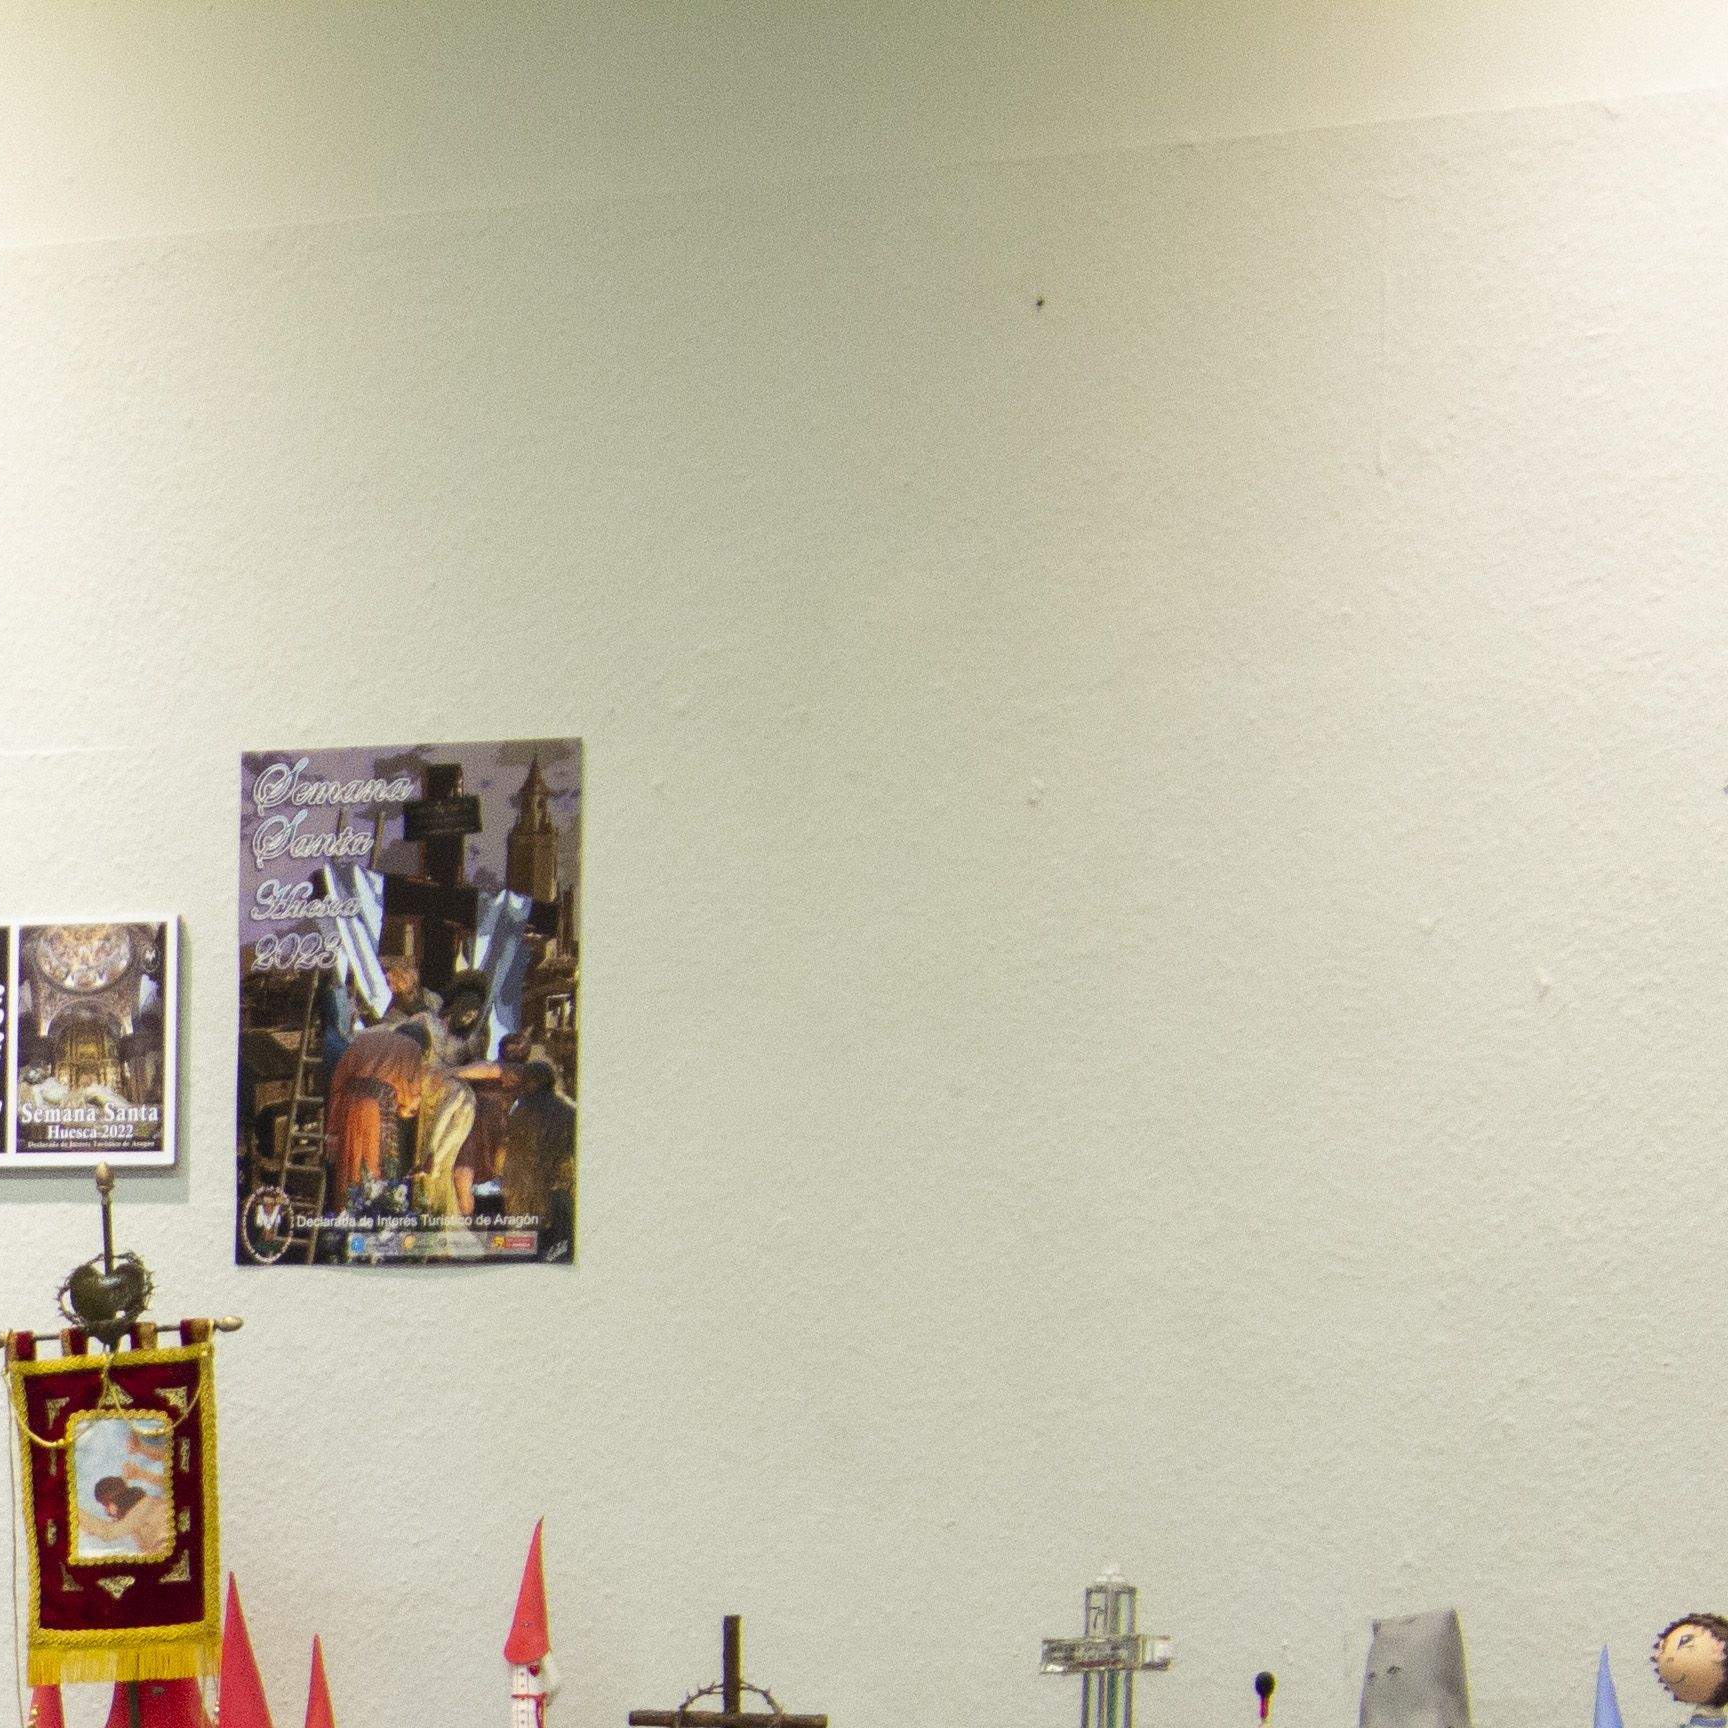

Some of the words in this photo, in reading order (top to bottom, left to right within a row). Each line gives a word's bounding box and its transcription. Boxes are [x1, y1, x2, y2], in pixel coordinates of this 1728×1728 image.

[253, 757, 415, 816] Semana
[252, 809, 374, 868] Santa
[251, 879, 361, 920] Huesca
[251, 932, 344, 972] 2023
[22, 1102, 96, 1124] Semana
[105, 1101, 159, 1122] Santa
[47, 1125, 97, 1139] Huesca
[99, 1124, 133, 1139] 2022
[297, 1215, 357, 1229] Declarada
[360, 1215, 375, 1229] de
[476, 1214, 490, 1228] de
